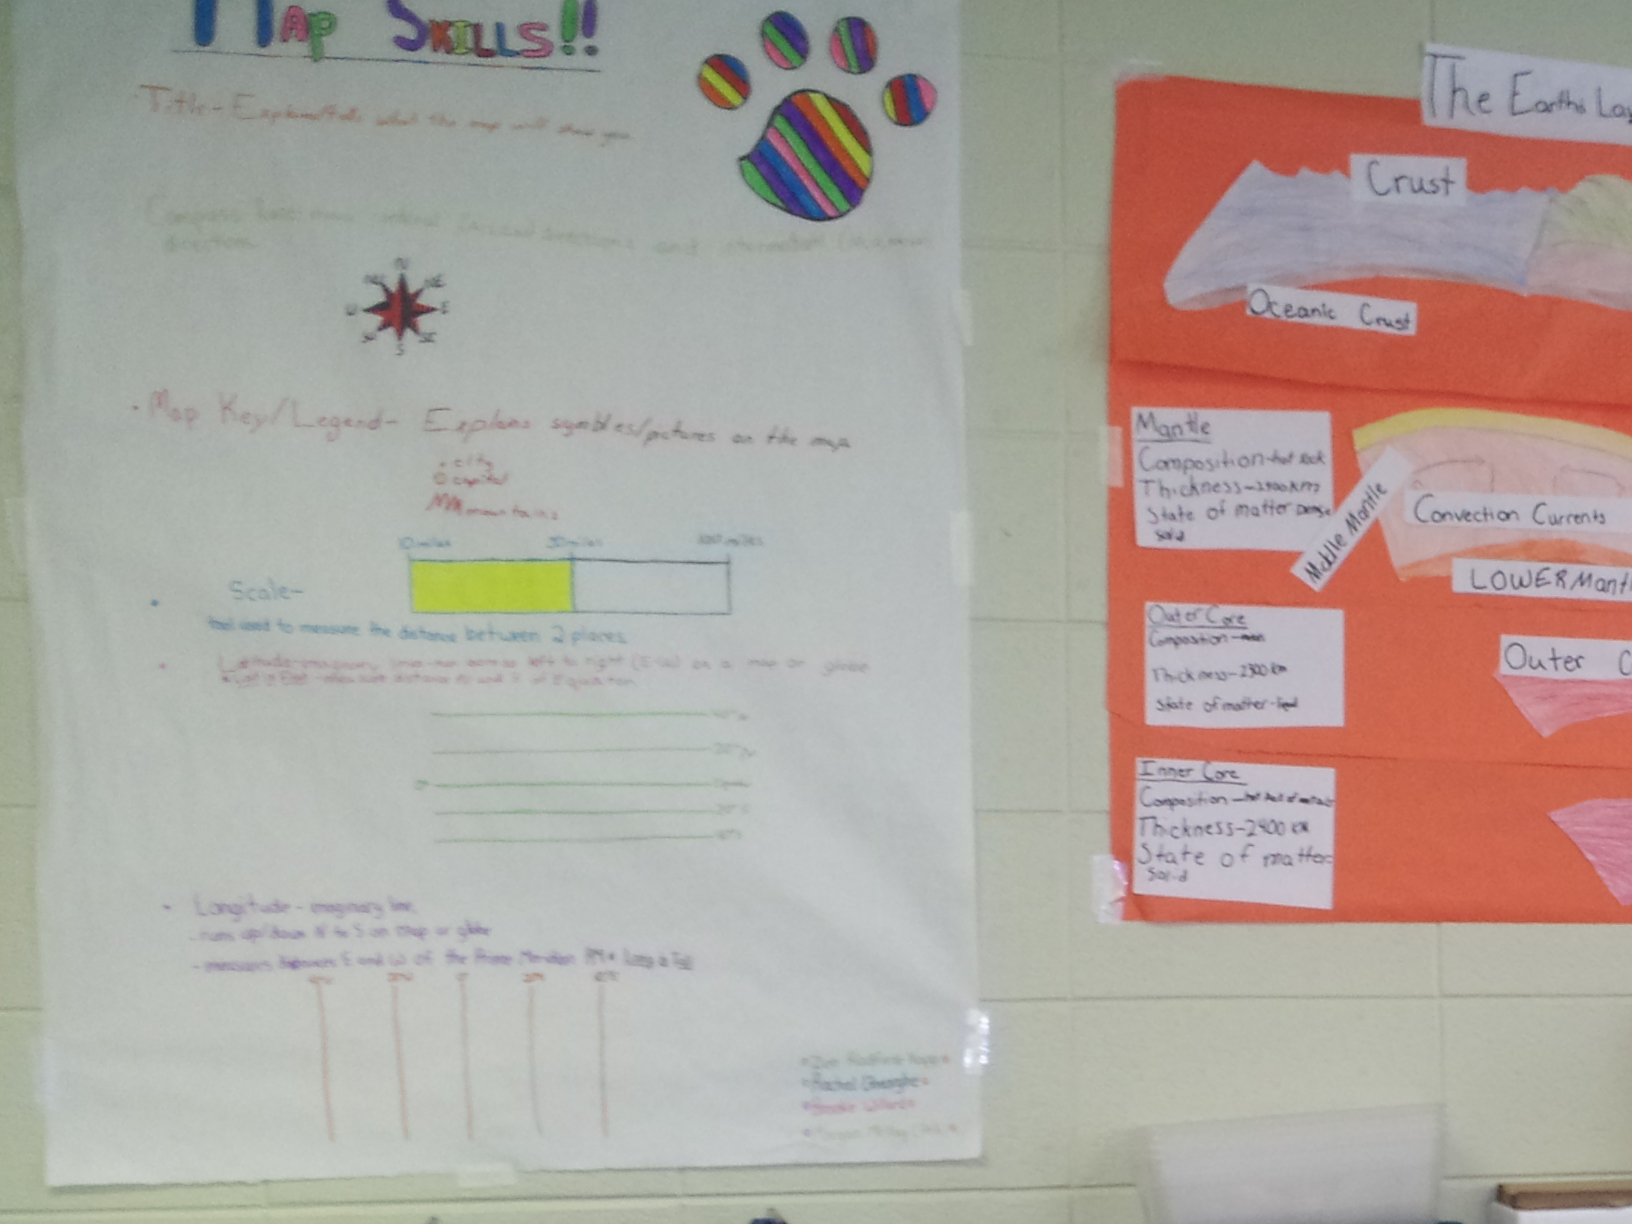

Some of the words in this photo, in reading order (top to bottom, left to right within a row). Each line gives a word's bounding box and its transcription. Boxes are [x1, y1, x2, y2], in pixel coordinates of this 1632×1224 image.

[1423, 51, 1493, 119] The
[1366, 159, 1456, 198] Crust
[1247, 286, 1338, 321] Oceanic
[1359, 301, 1411, 331] Crust
[1135, 411, 1212, 440] Mantle
[1147, 500, 1197, 525] State
[1206, 499, 1227, 521] of
[1344, 481, 1389, 537] Mantle
[1413, 492, 1520, 524] Convection
[1531, 500, 1607, 527] Currents
[1470, 566, 1569, 592] LOWER
[1147, 604, 1204, 625] Outer
[1204, 604, 1246, 626] Core
[1504, 641, 1586, 673] Outer
[1138, 760, 1194, 777] Inner
[1201, 760, 1241, 781] Core
[1137, 841, 1206, 866] State
[1219, 841, 1256, 869] of
